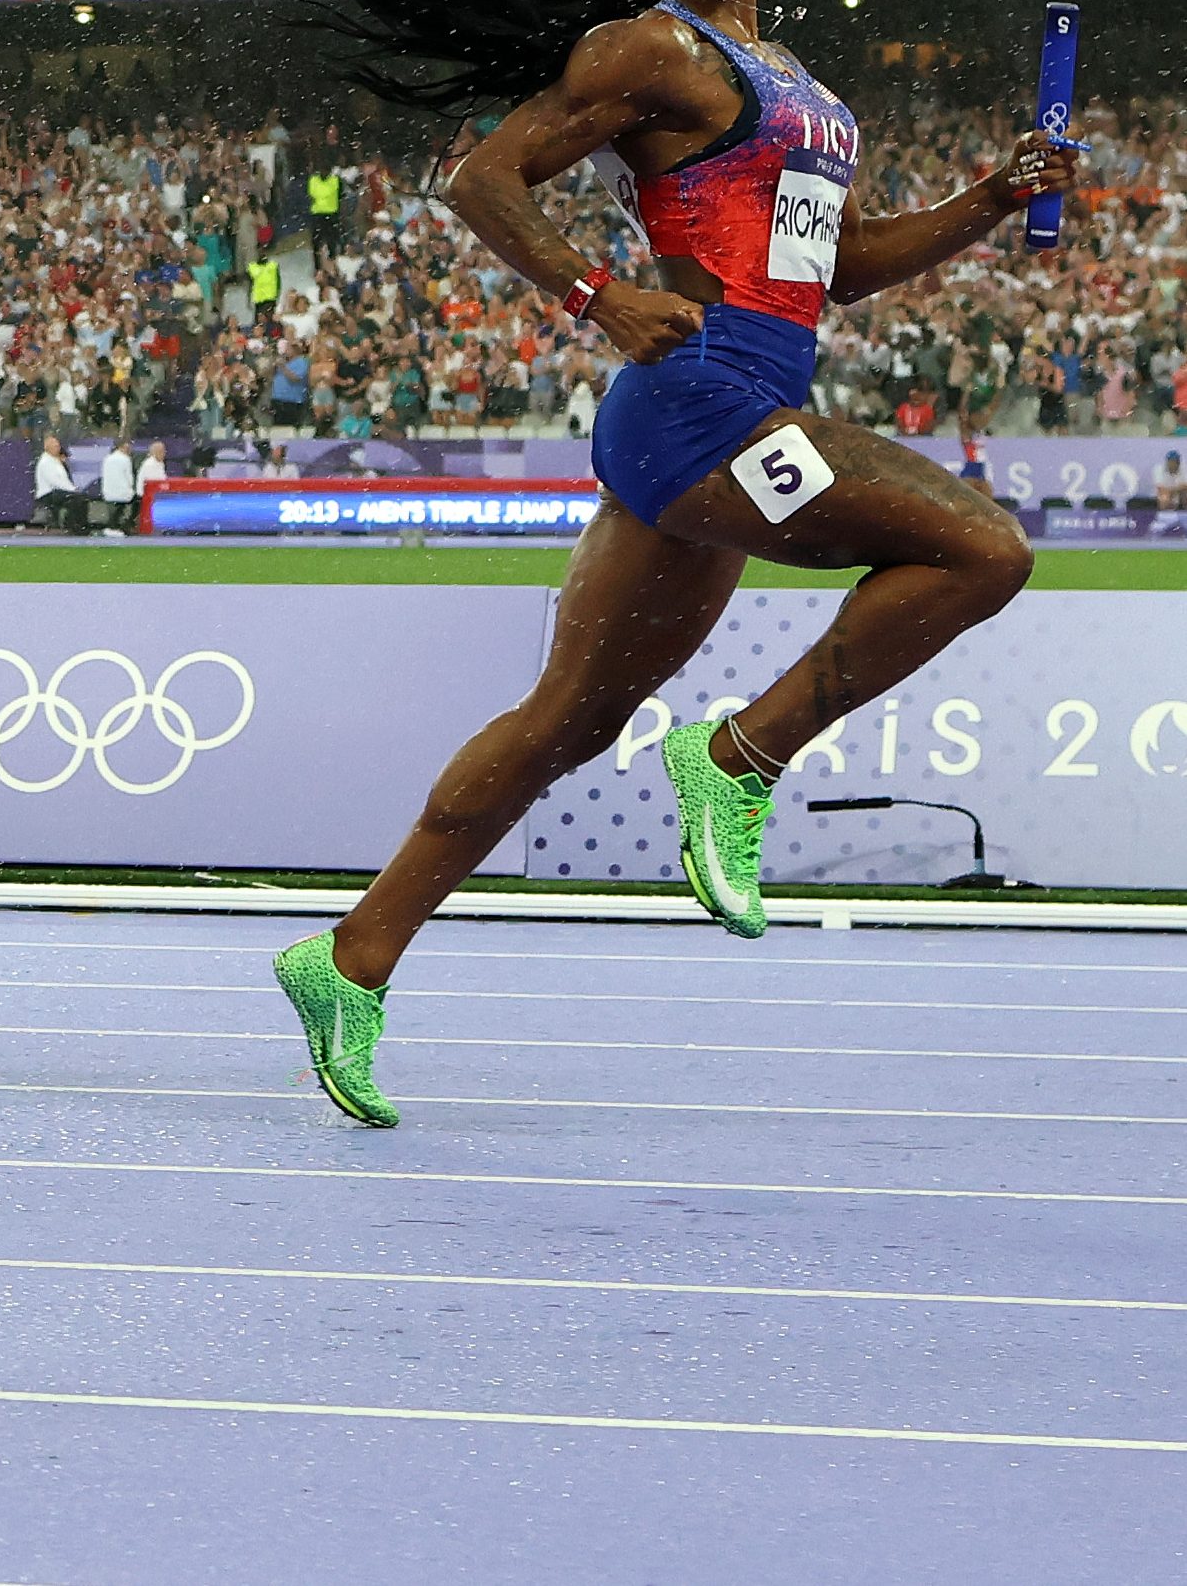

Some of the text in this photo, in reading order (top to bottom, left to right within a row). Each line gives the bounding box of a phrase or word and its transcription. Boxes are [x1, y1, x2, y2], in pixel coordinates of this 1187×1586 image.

[760, 448, 804, 496] 5
[428, 500, 500, 523] TRIPLE
[503, 501, 566, 523] JUMP
